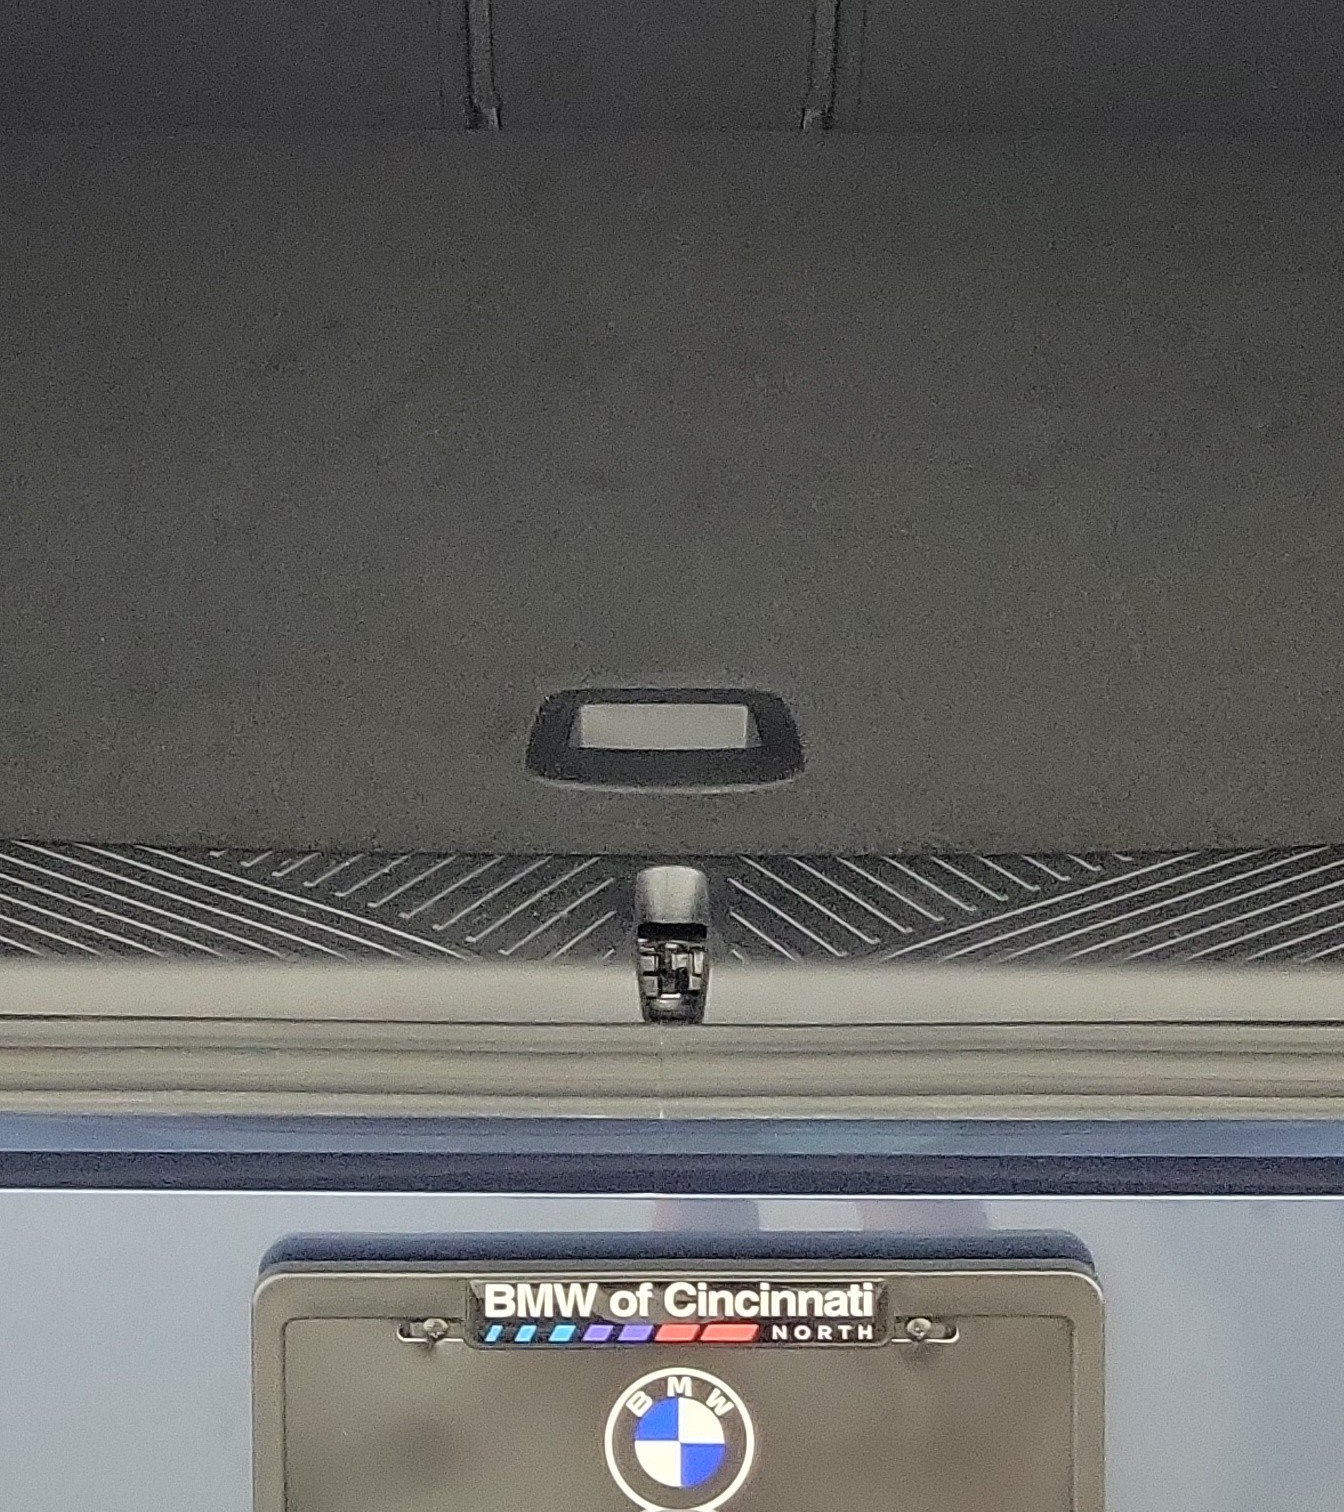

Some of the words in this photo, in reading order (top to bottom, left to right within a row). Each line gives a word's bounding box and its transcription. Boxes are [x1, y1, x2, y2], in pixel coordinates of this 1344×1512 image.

[484, 1282, 599, 1319] BMW
[609, 1282, 654, 1318] of
[663, 1281, 874, 1318] Cincinnati
[771, 1324, 874, 1341] NORTH
[625, 1375, 735, 1418] BMW
